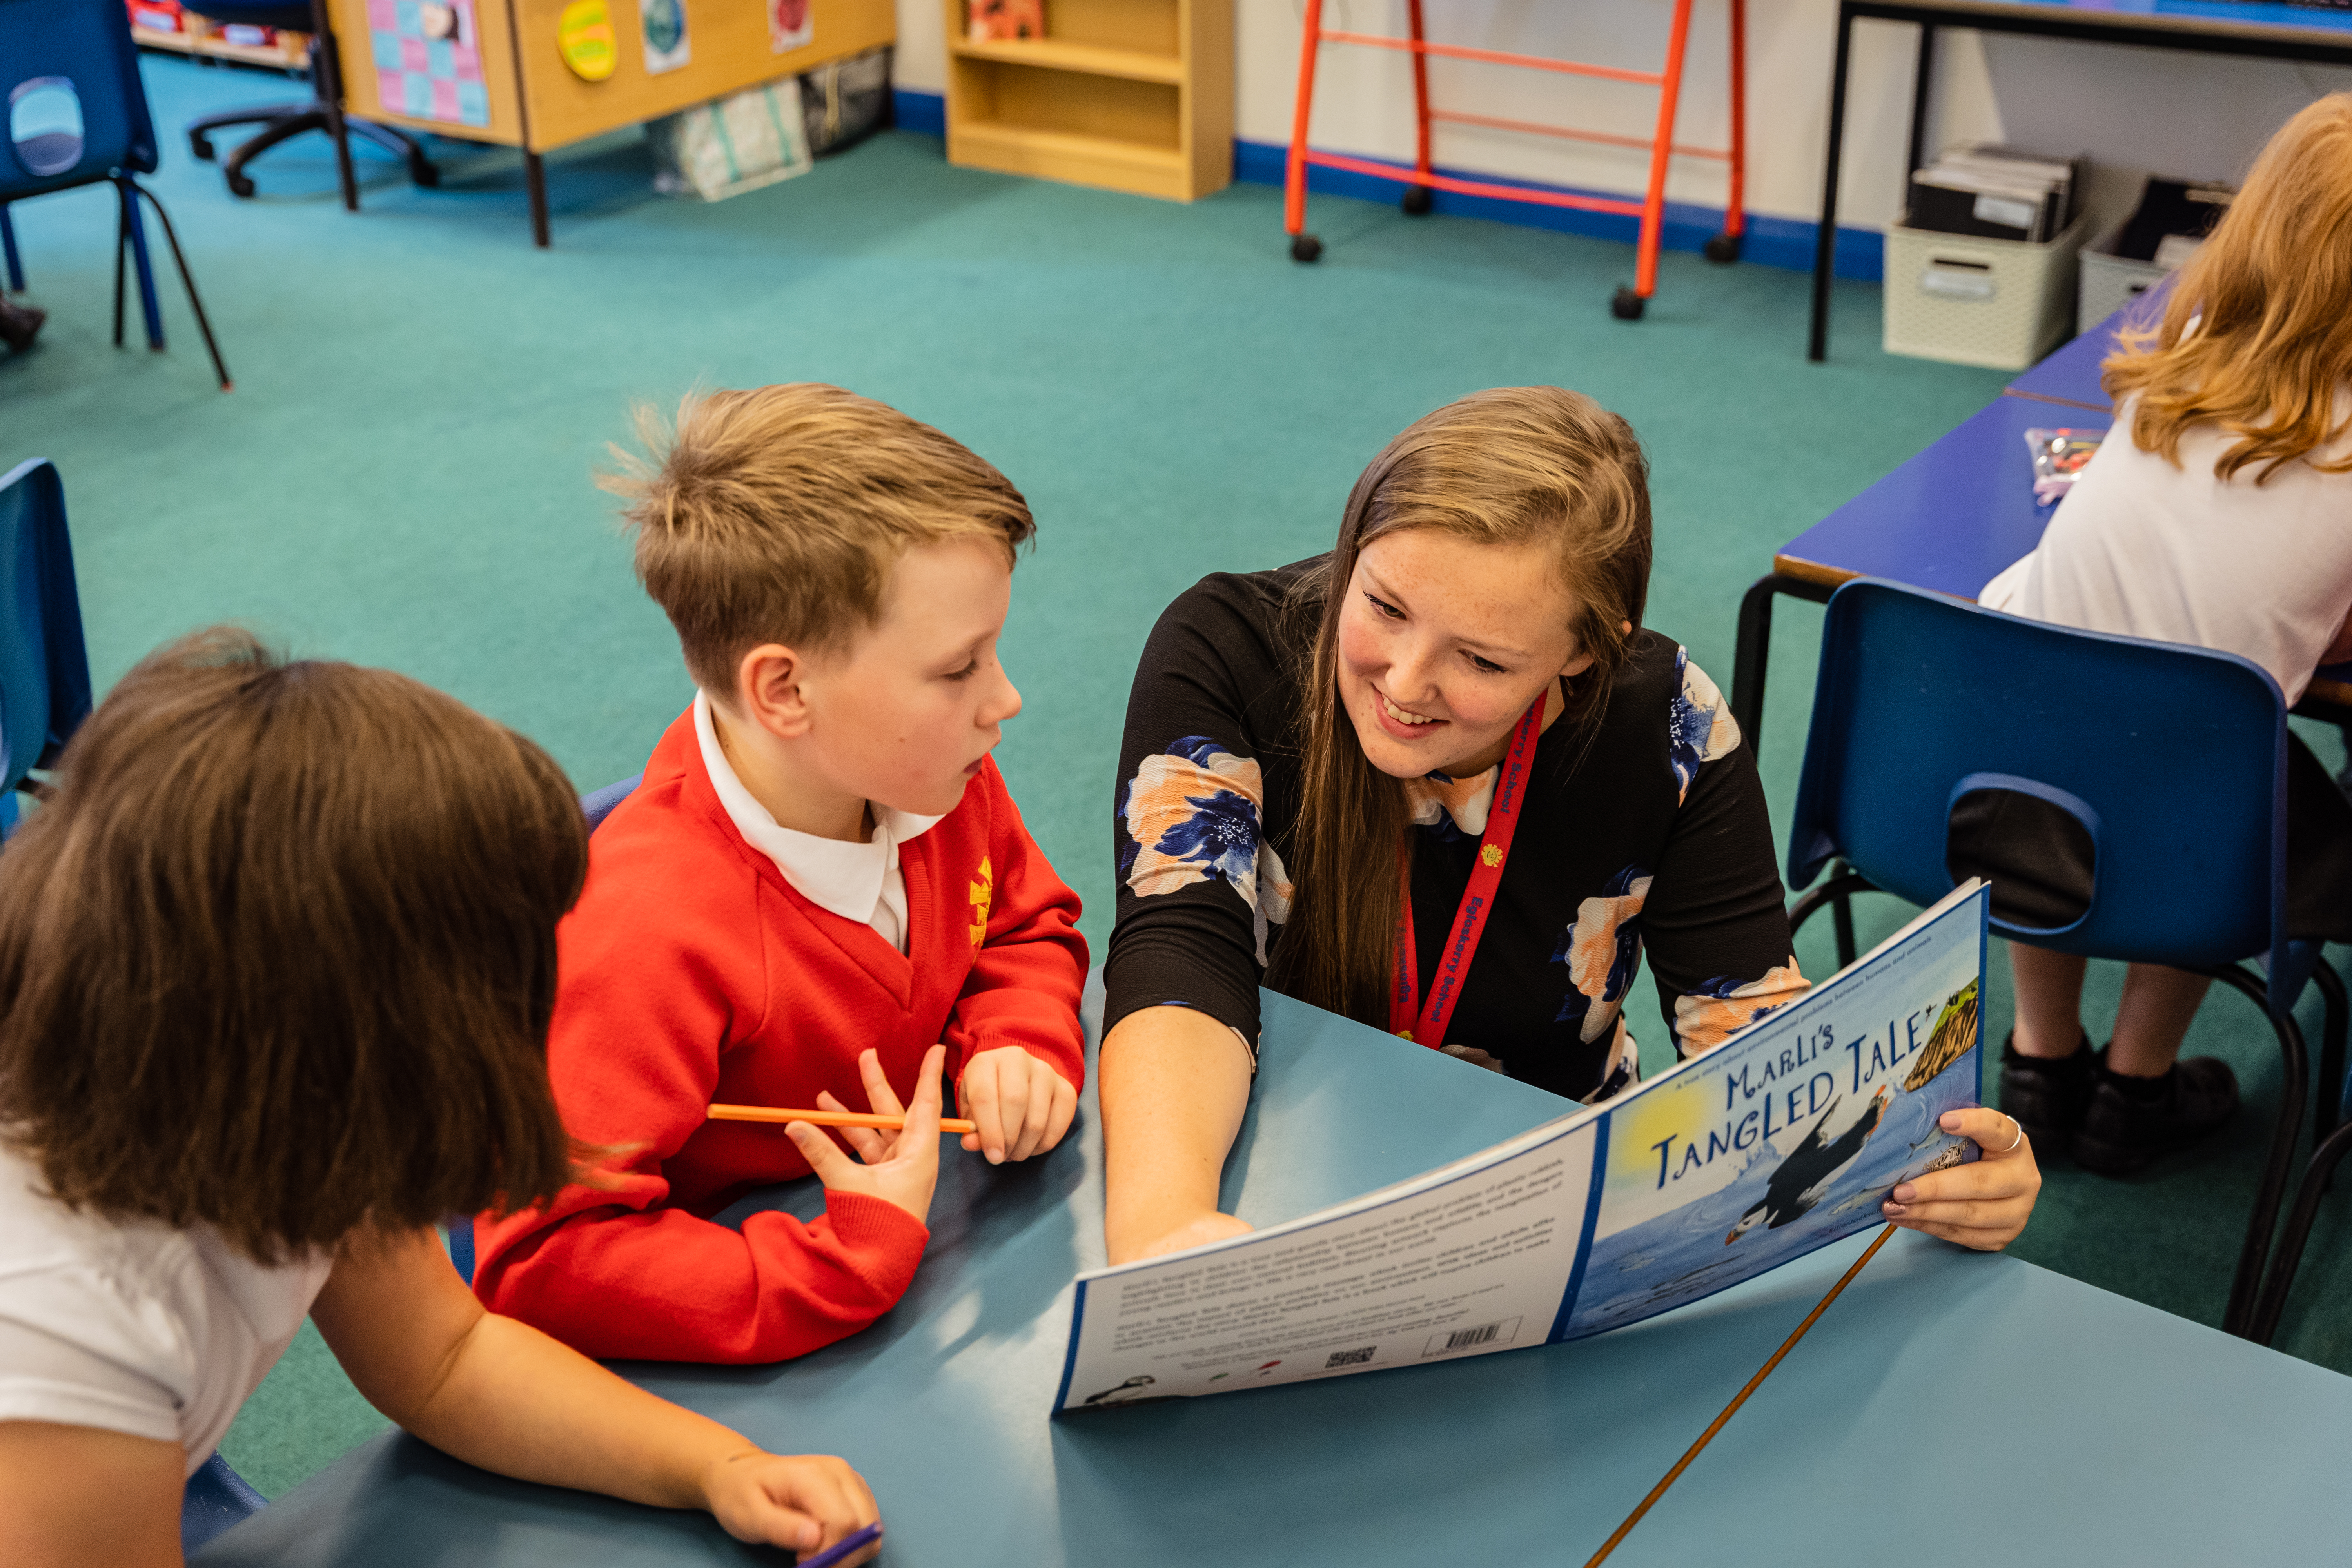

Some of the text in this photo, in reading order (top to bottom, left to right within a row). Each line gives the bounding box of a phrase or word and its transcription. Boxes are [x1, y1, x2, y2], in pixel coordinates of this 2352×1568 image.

[1500, 762, 1522, 813] School
[1430, 896, 1483, 1022] Egloskerry School
[1722, 1049, 1745, 1066] about
[1747, 1016, 1799, 1052] environmental
[1800, 998, 1833, 1023] problems
[1834, 980, 1864, 1001] between
[1865, 963, 1891, 981] humans
[1892, 951, 1906, 965] and
[1907, 935, 1932, 956] animals
[1650, 1010, 1923, 1190] TANGLED TALE
[1949, 1137, 1969, 1159] TRIBE
